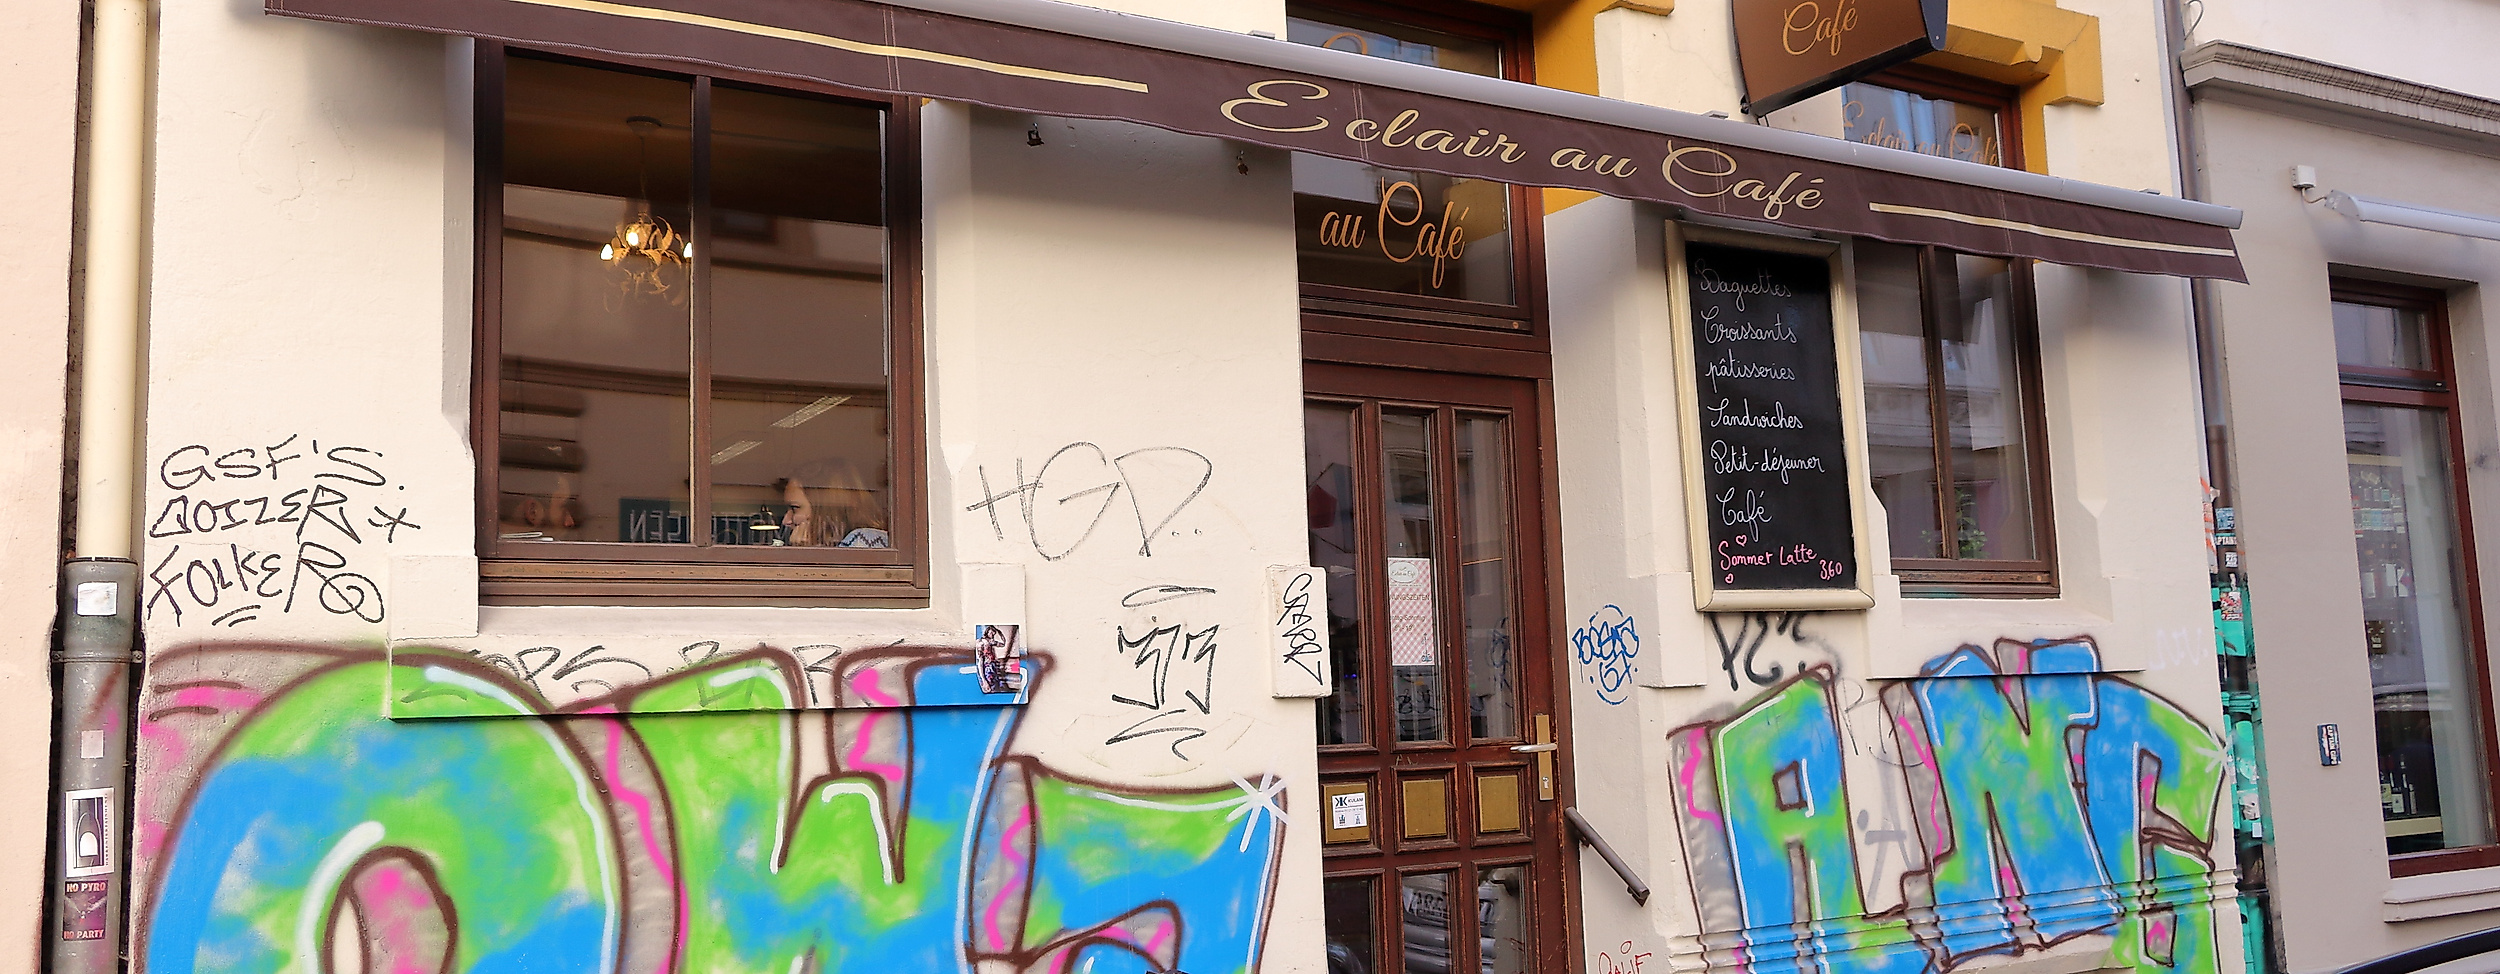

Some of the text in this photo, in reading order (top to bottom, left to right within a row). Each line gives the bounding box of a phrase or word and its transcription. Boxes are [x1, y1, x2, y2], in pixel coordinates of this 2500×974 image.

[1549, 140, 1638, 179] au
[1661, 139, 1825, 221] Café
[1320, 176, 1467, 289] au Café
[1694, 258, 1793, 312] Baguettes
[1700, 305, 1798, 346] Croissants
[1705, 348, 1796, 393] pâtisseries
[1707, 398, 1804, 430] Sandwiches
[1710, 439, 1826, 485] Petit-déjeuner
[1715, 486, 1773, 542] Café
[1717, 540, 1818, 571] Sommer Latte
[1819, 558, 1843, 582] 3,60
[66, 882, 106, 892] NO PYRO
[63, 930, 104, 939] NO PARTY
